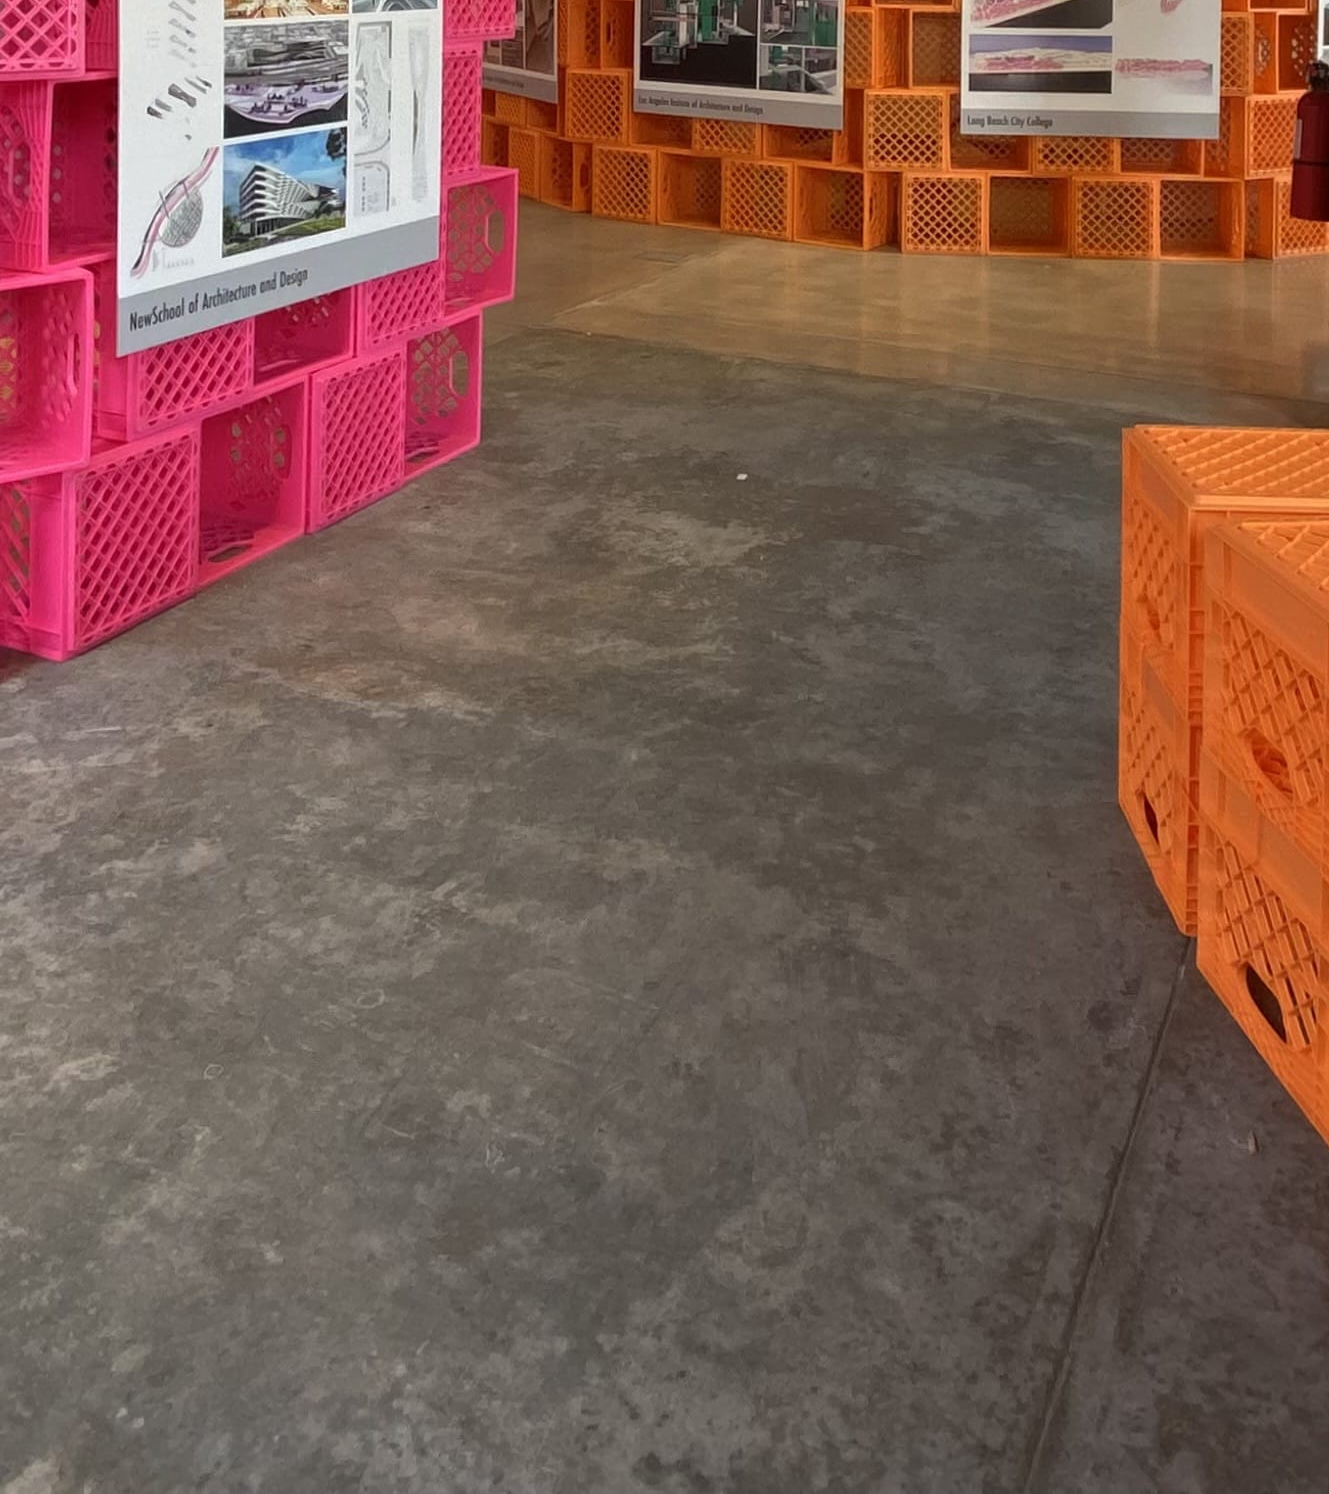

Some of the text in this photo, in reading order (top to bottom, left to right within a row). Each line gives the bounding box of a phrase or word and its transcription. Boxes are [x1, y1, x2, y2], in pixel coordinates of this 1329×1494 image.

[129, 268, 308, 331] NewSchool of Architecture and Design
